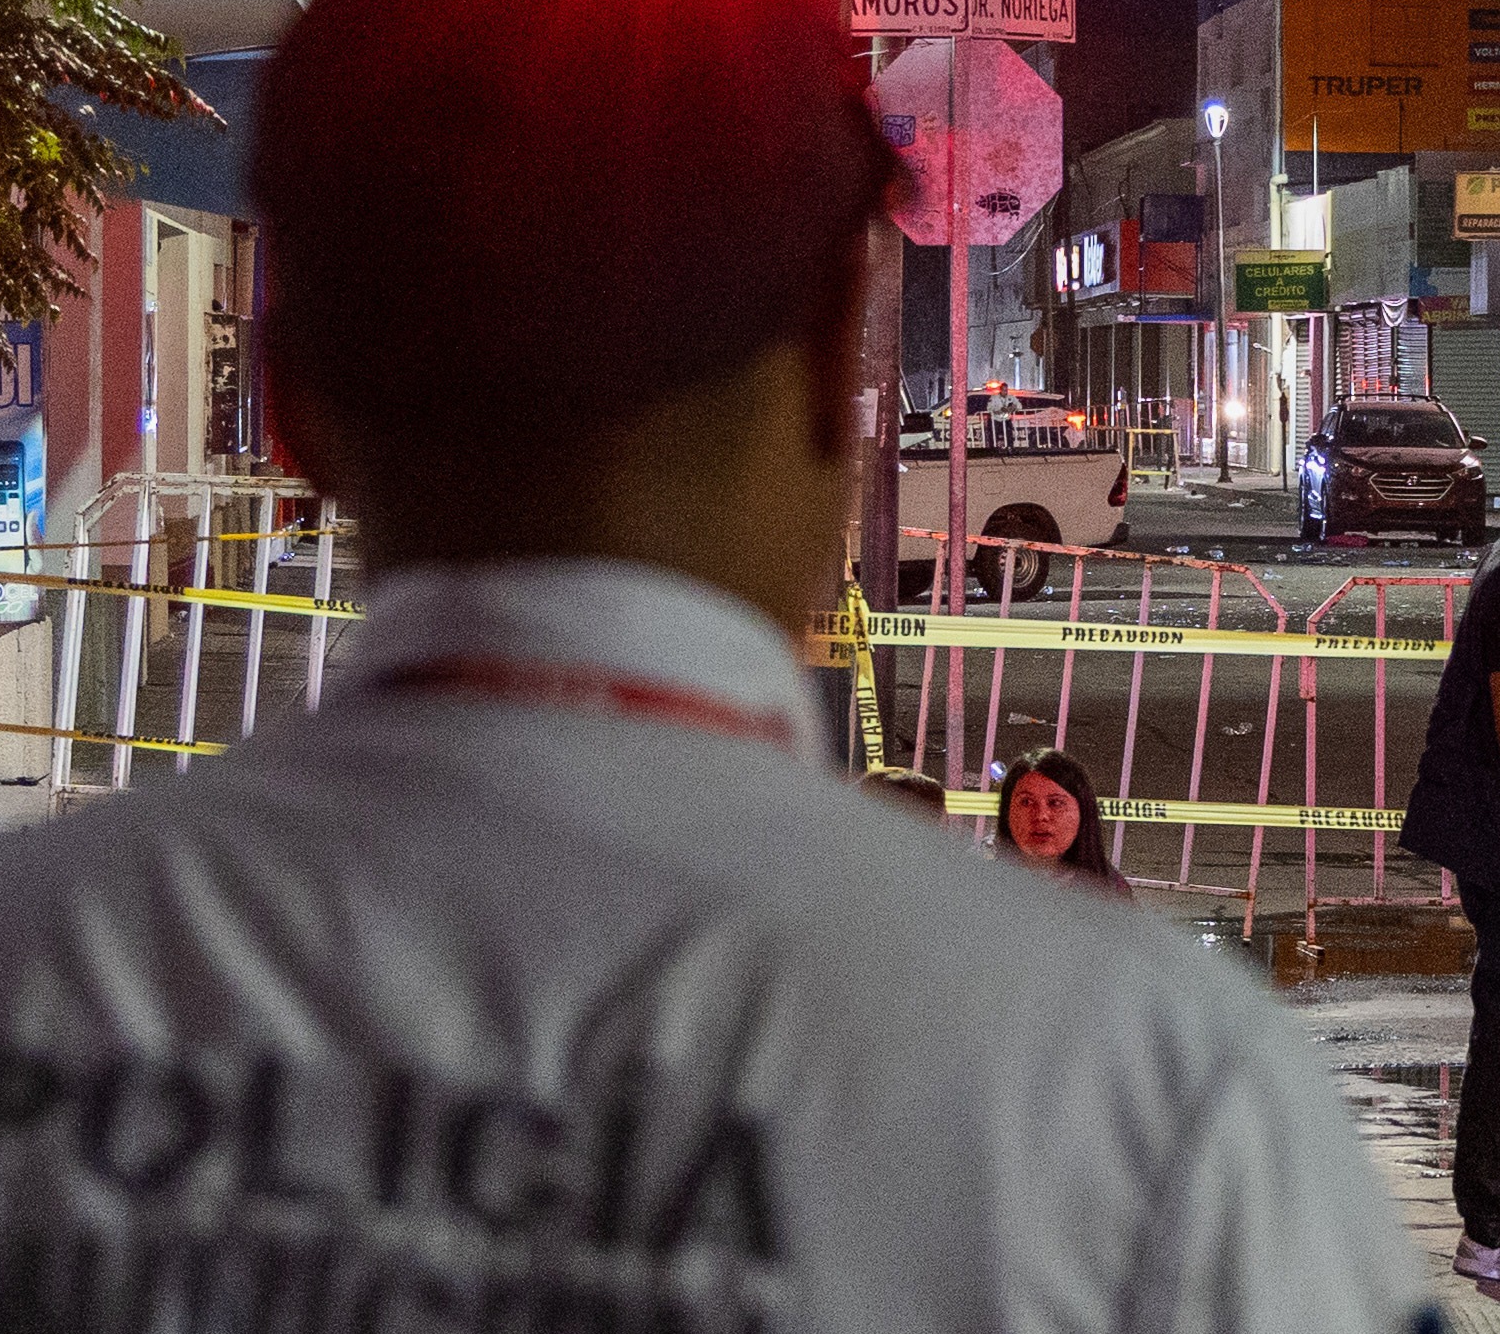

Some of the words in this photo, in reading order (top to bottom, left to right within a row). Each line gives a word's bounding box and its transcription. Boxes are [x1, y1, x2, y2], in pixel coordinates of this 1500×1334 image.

[1308, 75, 1422, 96] TRUPER
[1245, 265, 1315, 279] CELULARES
[1061, 627, 1184, 645] PRECAUCION
[1299, 809, 1404, 828] PRECAUCIO
